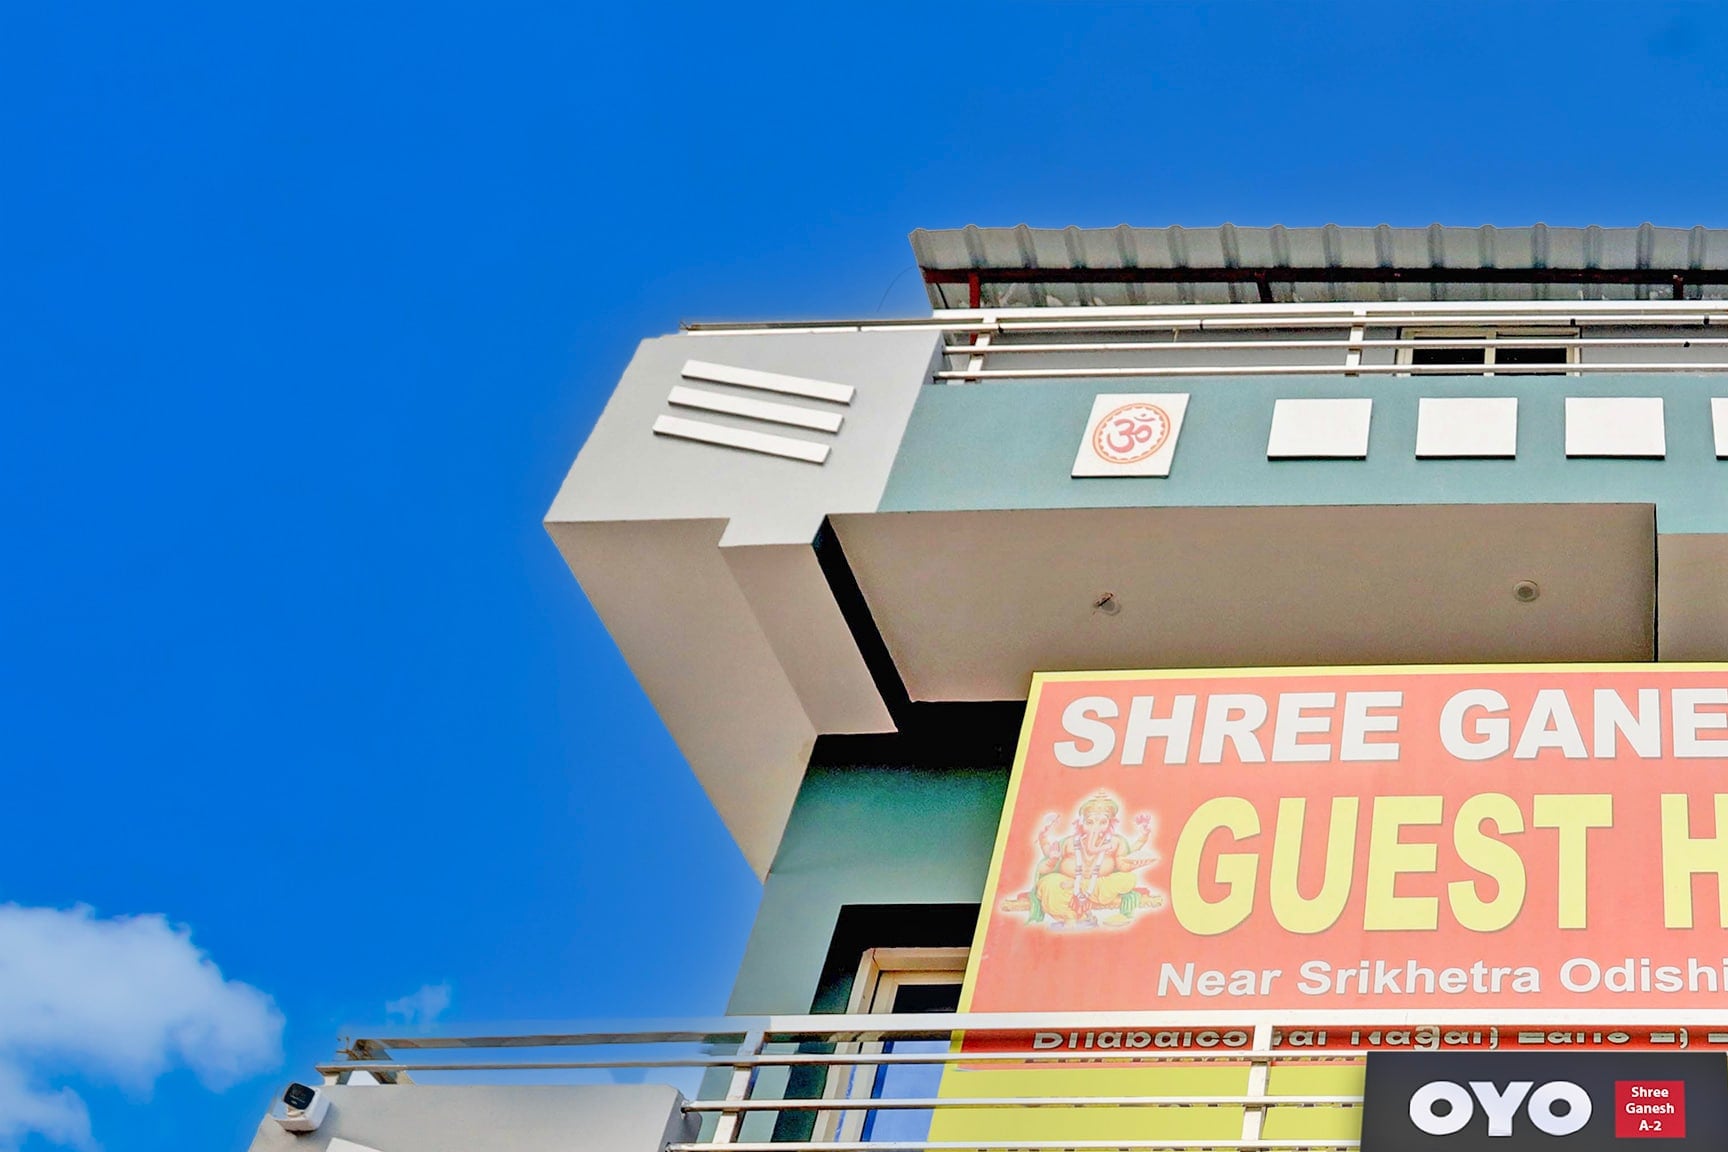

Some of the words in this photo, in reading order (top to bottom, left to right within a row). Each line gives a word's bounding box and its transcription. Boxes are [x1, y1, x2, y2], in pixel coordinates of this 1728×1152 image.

[1053, 690, 1402, 768] SHREE
[1170, 793, 1614, 935] GUEST
[1157, 962, 1281, 996] Near
[1296, 957, 1542, 997] Srikhetra
[1408, 1080, 1593, 1138] OYO
[1625, 1102, 1675, 1114] Ganesh
[1631, 1086, 1669, 1098] Shree
[1638, 1120, 1662, 1131] A-2
